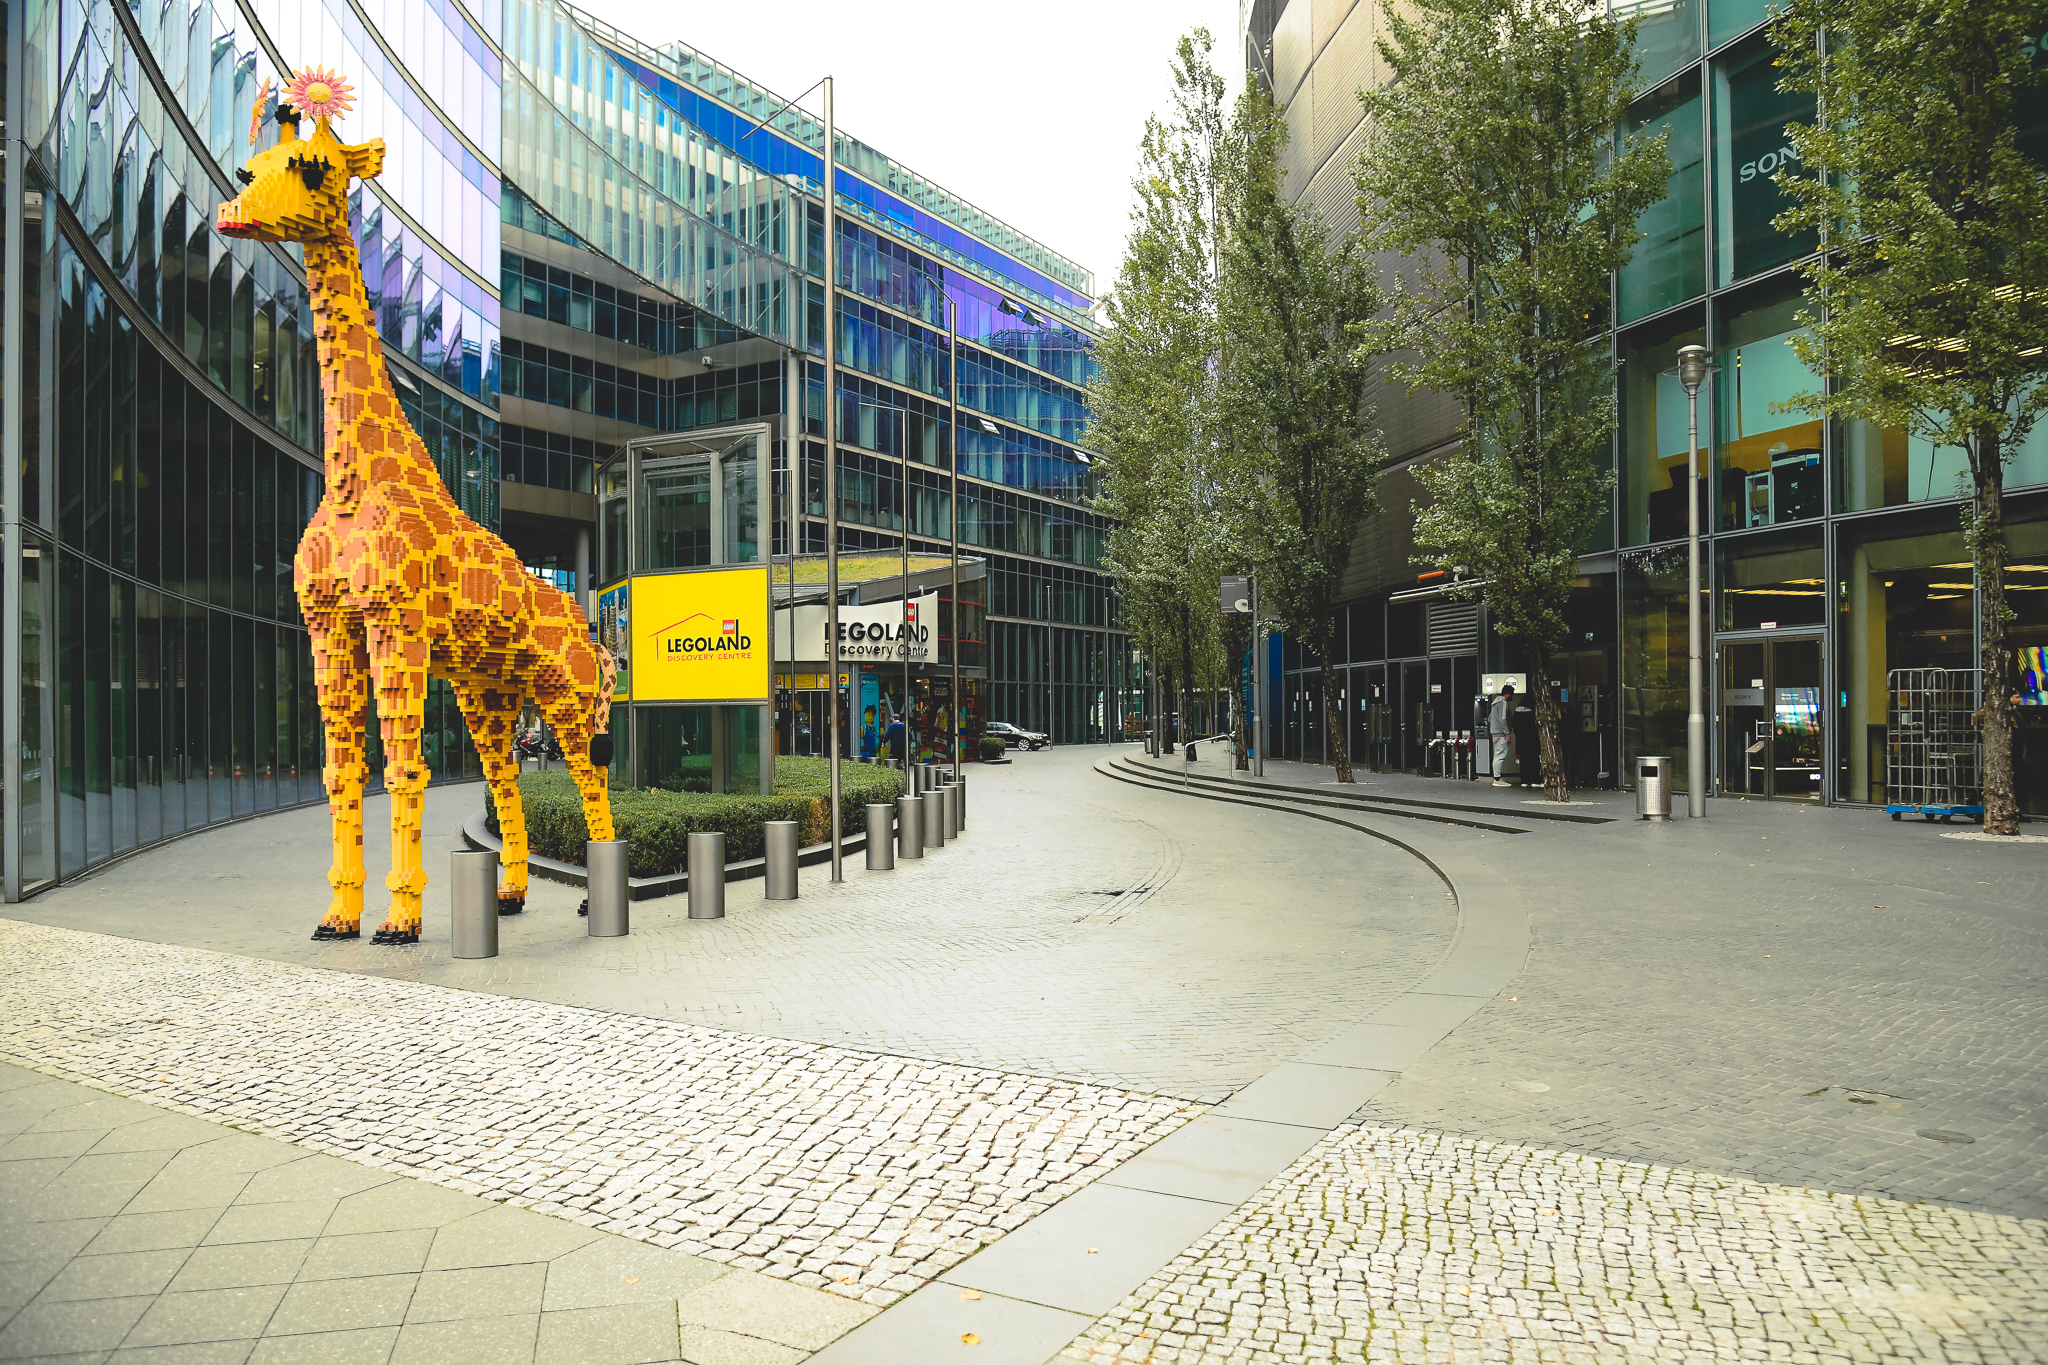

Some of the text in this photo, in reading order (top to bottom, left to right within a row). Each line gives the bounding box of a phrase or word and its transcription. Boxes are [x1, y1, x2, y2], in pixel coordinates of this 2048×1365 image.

[1740, 144, 1797, 183] SON
[667, 619, 751, 652] LEGOLAND
[667, 652, 752, 662] DISCOVERY CENTRE
